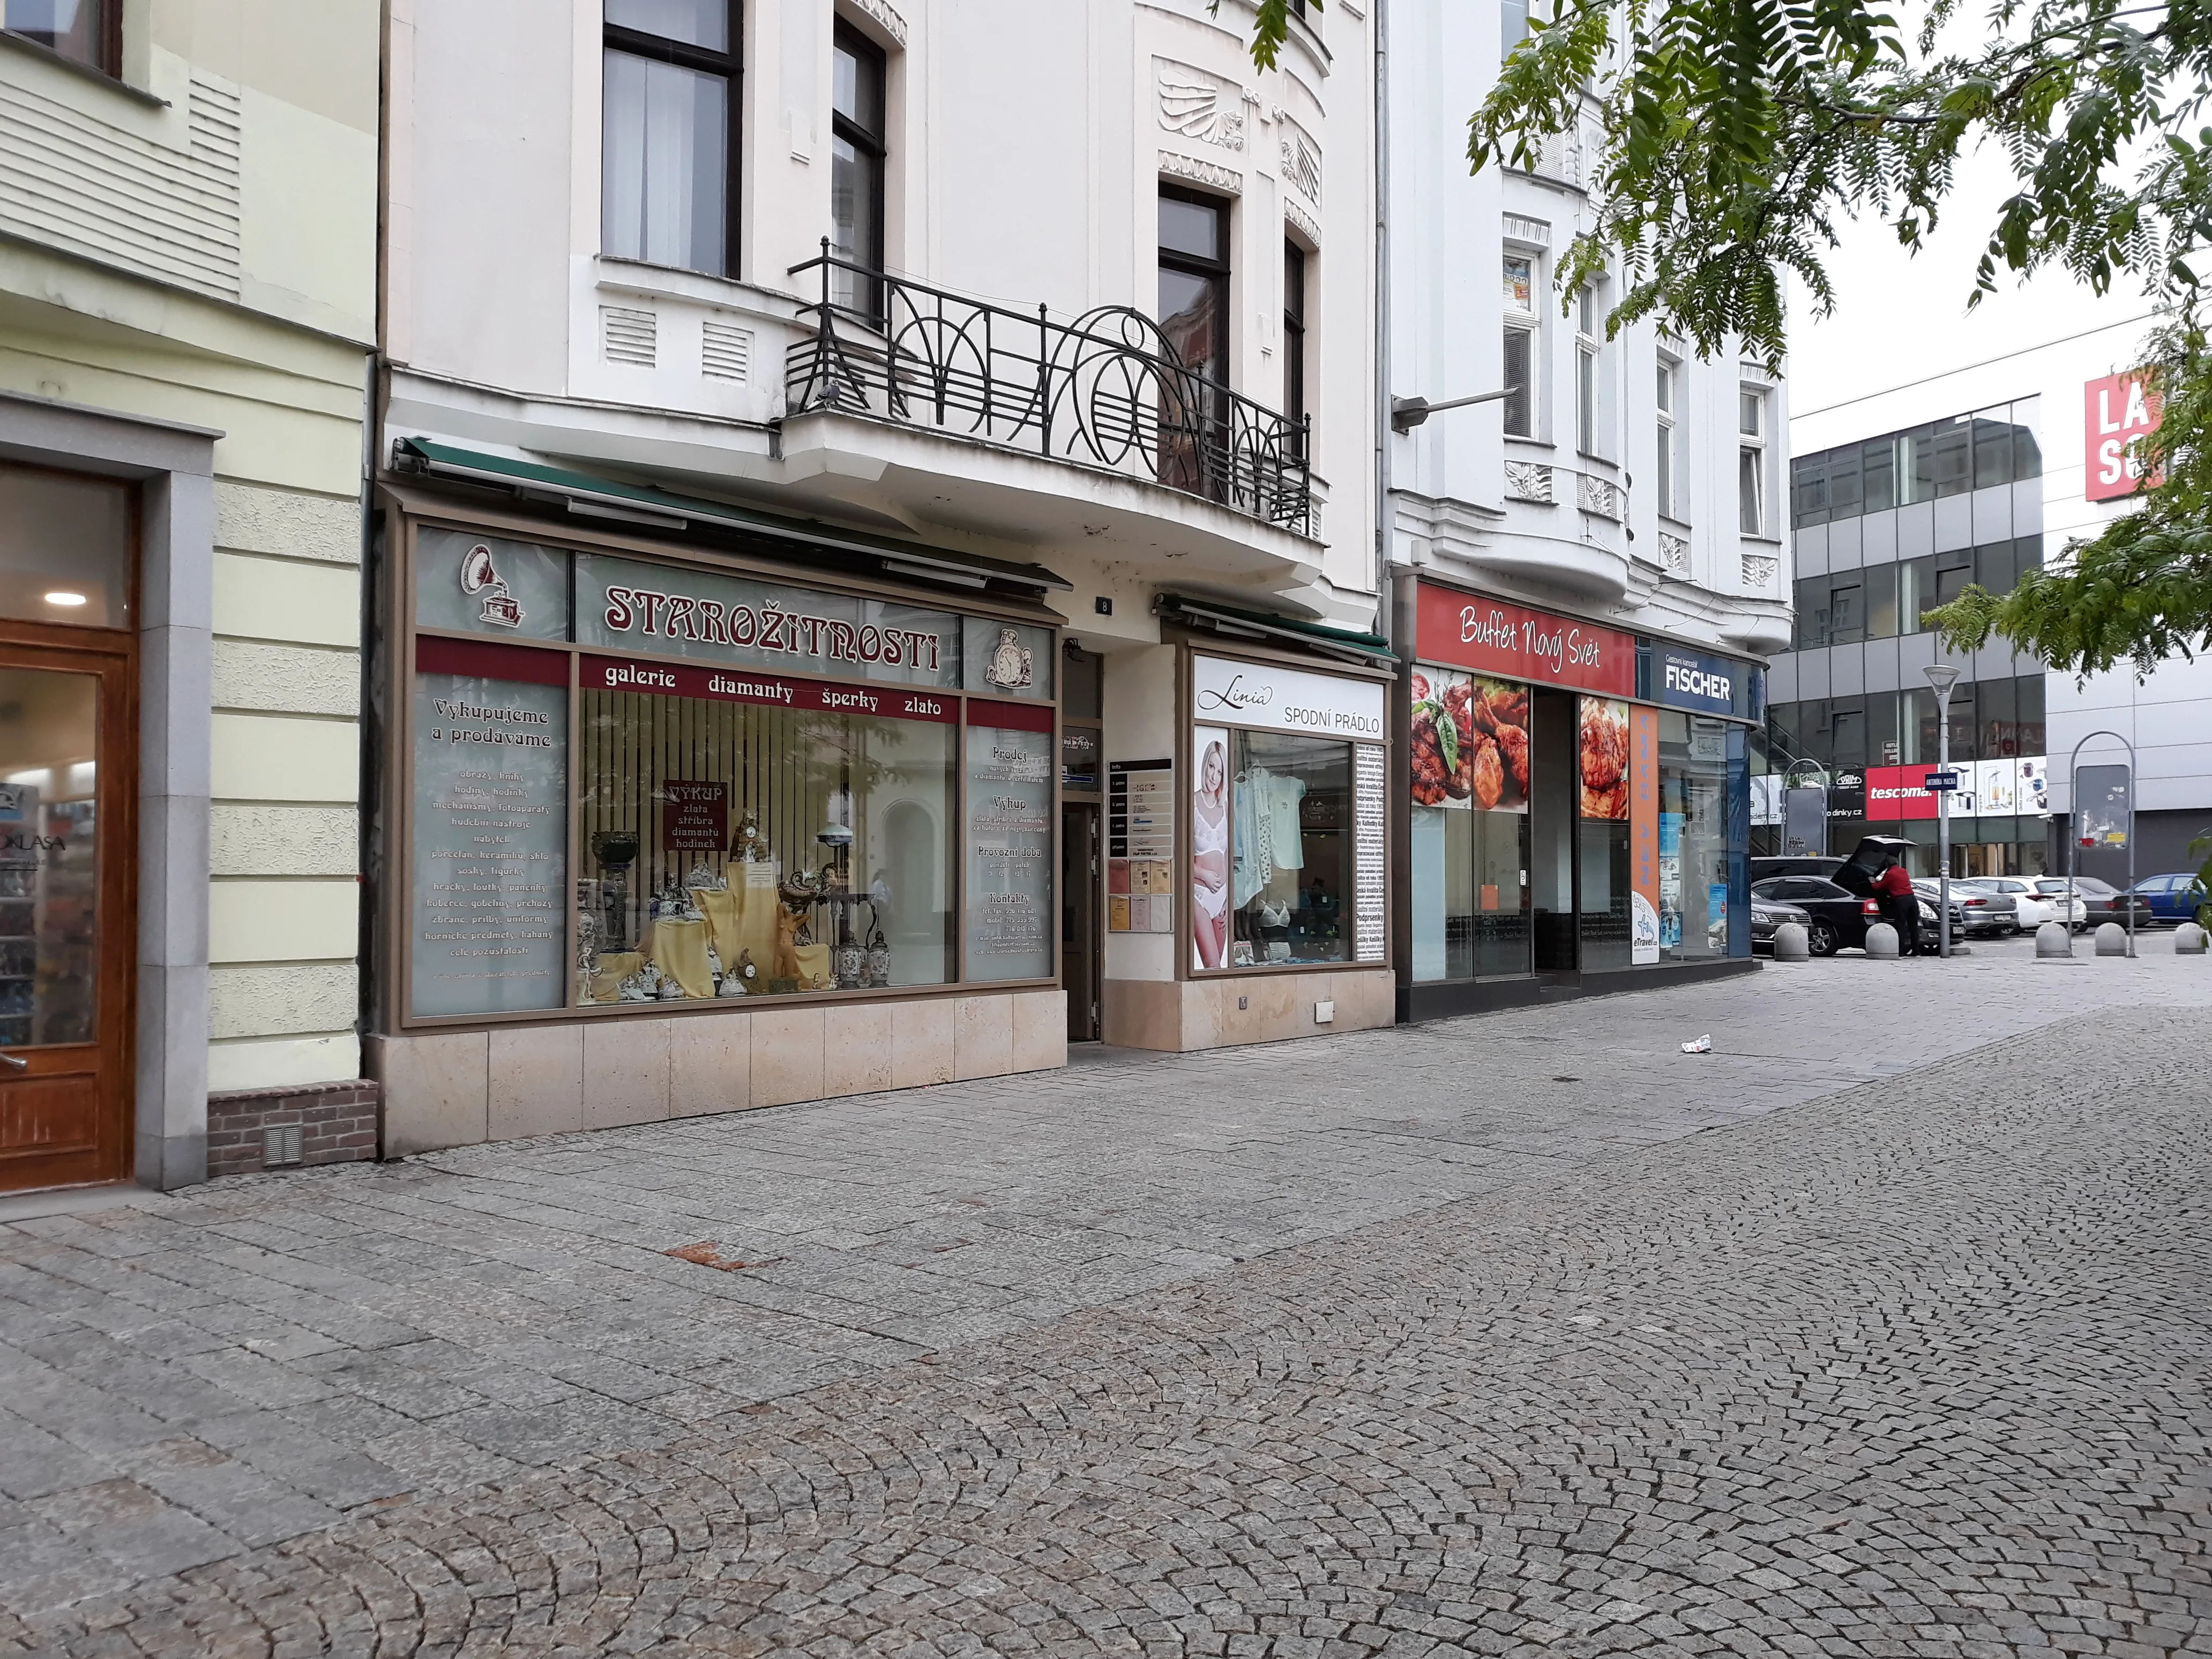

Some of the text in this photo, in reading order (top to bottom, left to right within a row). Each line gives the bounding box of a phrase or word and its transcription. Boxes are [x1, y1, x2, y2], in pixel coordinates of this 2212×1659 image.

[2098, 381, 2149, 435] LA
[1102, 601, 1108, 612] 8
[605, 585, 940, 672] STAROŽITNOSTI
[1460, 606, 1601, 674] Buffet Nový Svět
[1665, 665, 1730, 701] FISCHER
[606, 665, 941, 715] galerie diamanty šperky zlato
[1198, 675, 1273, 710] Linia
[433, 698, 549, 724] Vykupujeme
[1284, 707, 1379, 734] SPODNÍ PRÁDLO
[431, 727, 551, 748] a prodáváme
[992, 746, 1027, 763] Prodej
[499, 772, 525, 782] knihy
[1841, 775, 1858, 783] PRIM
[493, 787, 528, 798] hodinky
[669, 783, 722, 801] VÝKUP
[1871, 787, 1932, 799] tescoma.
[683, 804, 708, 813] zlata
[992, 795, 1027, 812] Výkup
[1826, 809, 1863, 817] odinky.cz
[678, 816, 713, 825] stříbra
[672, 827, 719, 836] diamantů
[676, 839, 716, 848] hodinek
[529, 851, 548, 861] sklo
[978, 846, 1041, 858] Provozní doba
[491, 867, 525, 877] figurky
[509, 883, 547, 893] panenky
[989, 892, 1030, 906] Kontakty
[506, 915, 548, 924] uniformy
